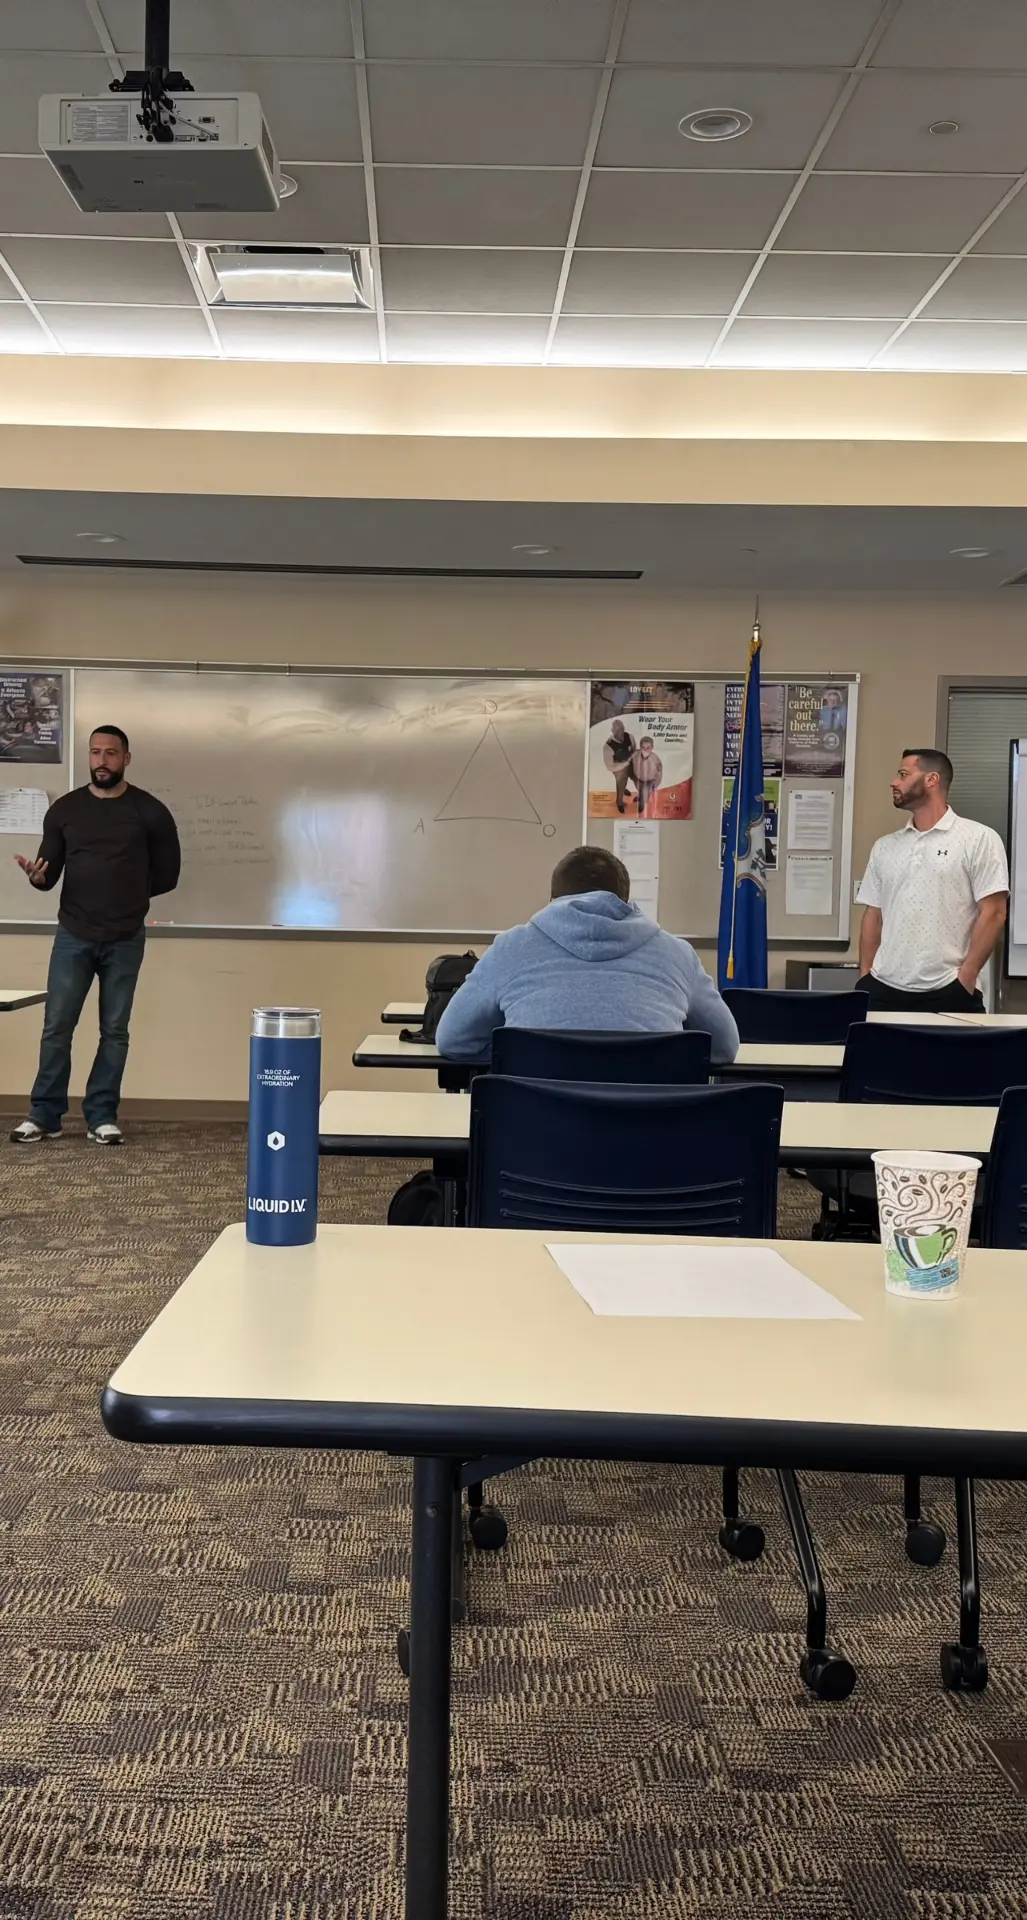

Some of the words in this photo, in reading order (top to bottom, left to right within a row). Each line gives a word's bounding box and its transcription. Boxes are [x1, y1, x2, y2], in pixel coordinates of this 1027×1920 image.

[788, 698, 824, 710] careful
[796, 710, 812, 721] out
[647, 723, 666, 731] Body
[413, 817, 425, 835] A
[256, 1073, 301, 1081] EXTRAORDINARY
[248, 1196, 290, 1213] LIQUID
